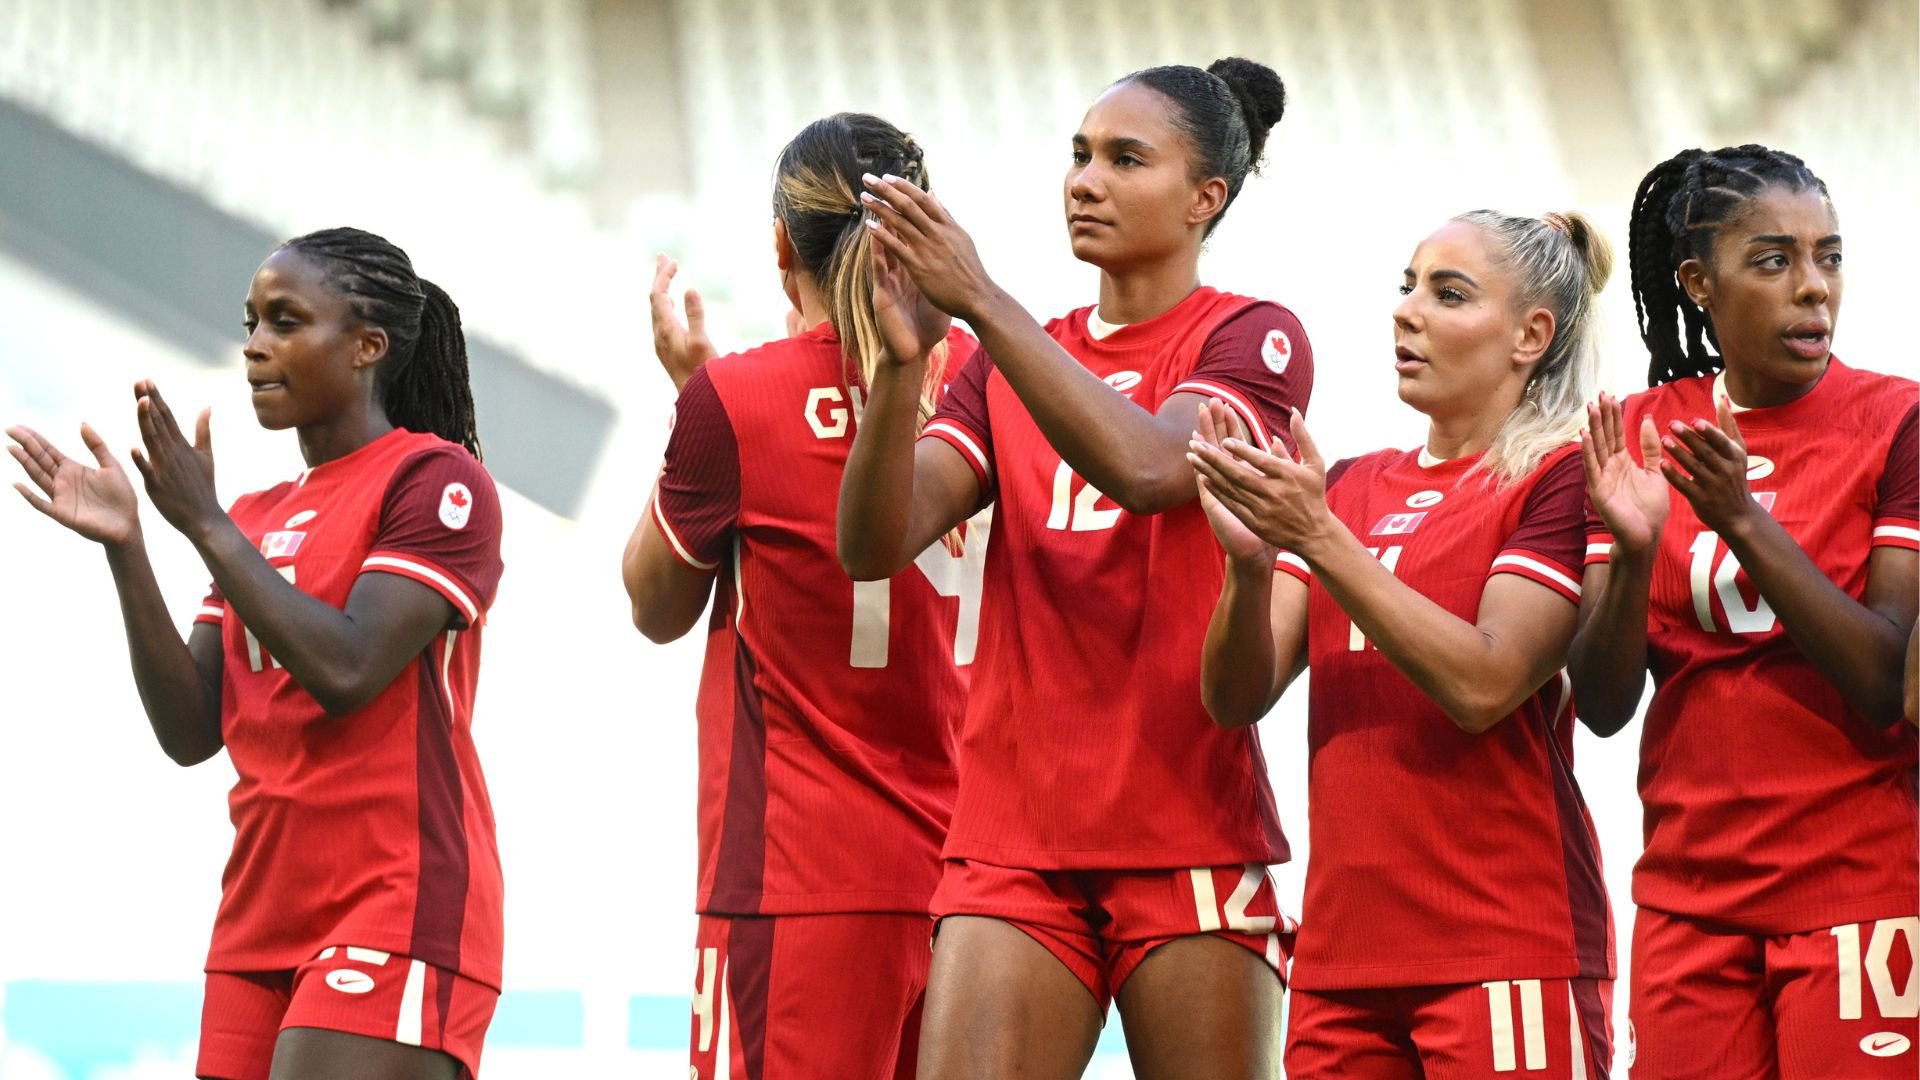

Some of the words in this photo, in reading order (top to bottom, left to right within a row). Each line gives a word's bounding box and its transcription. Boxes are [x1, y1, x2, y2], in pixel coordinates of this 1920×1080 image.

[1689, 531, 1777, 634] 10
[1830, 916, 1920, 1020] 10
[1481, 979, 1548, 1072] 11
